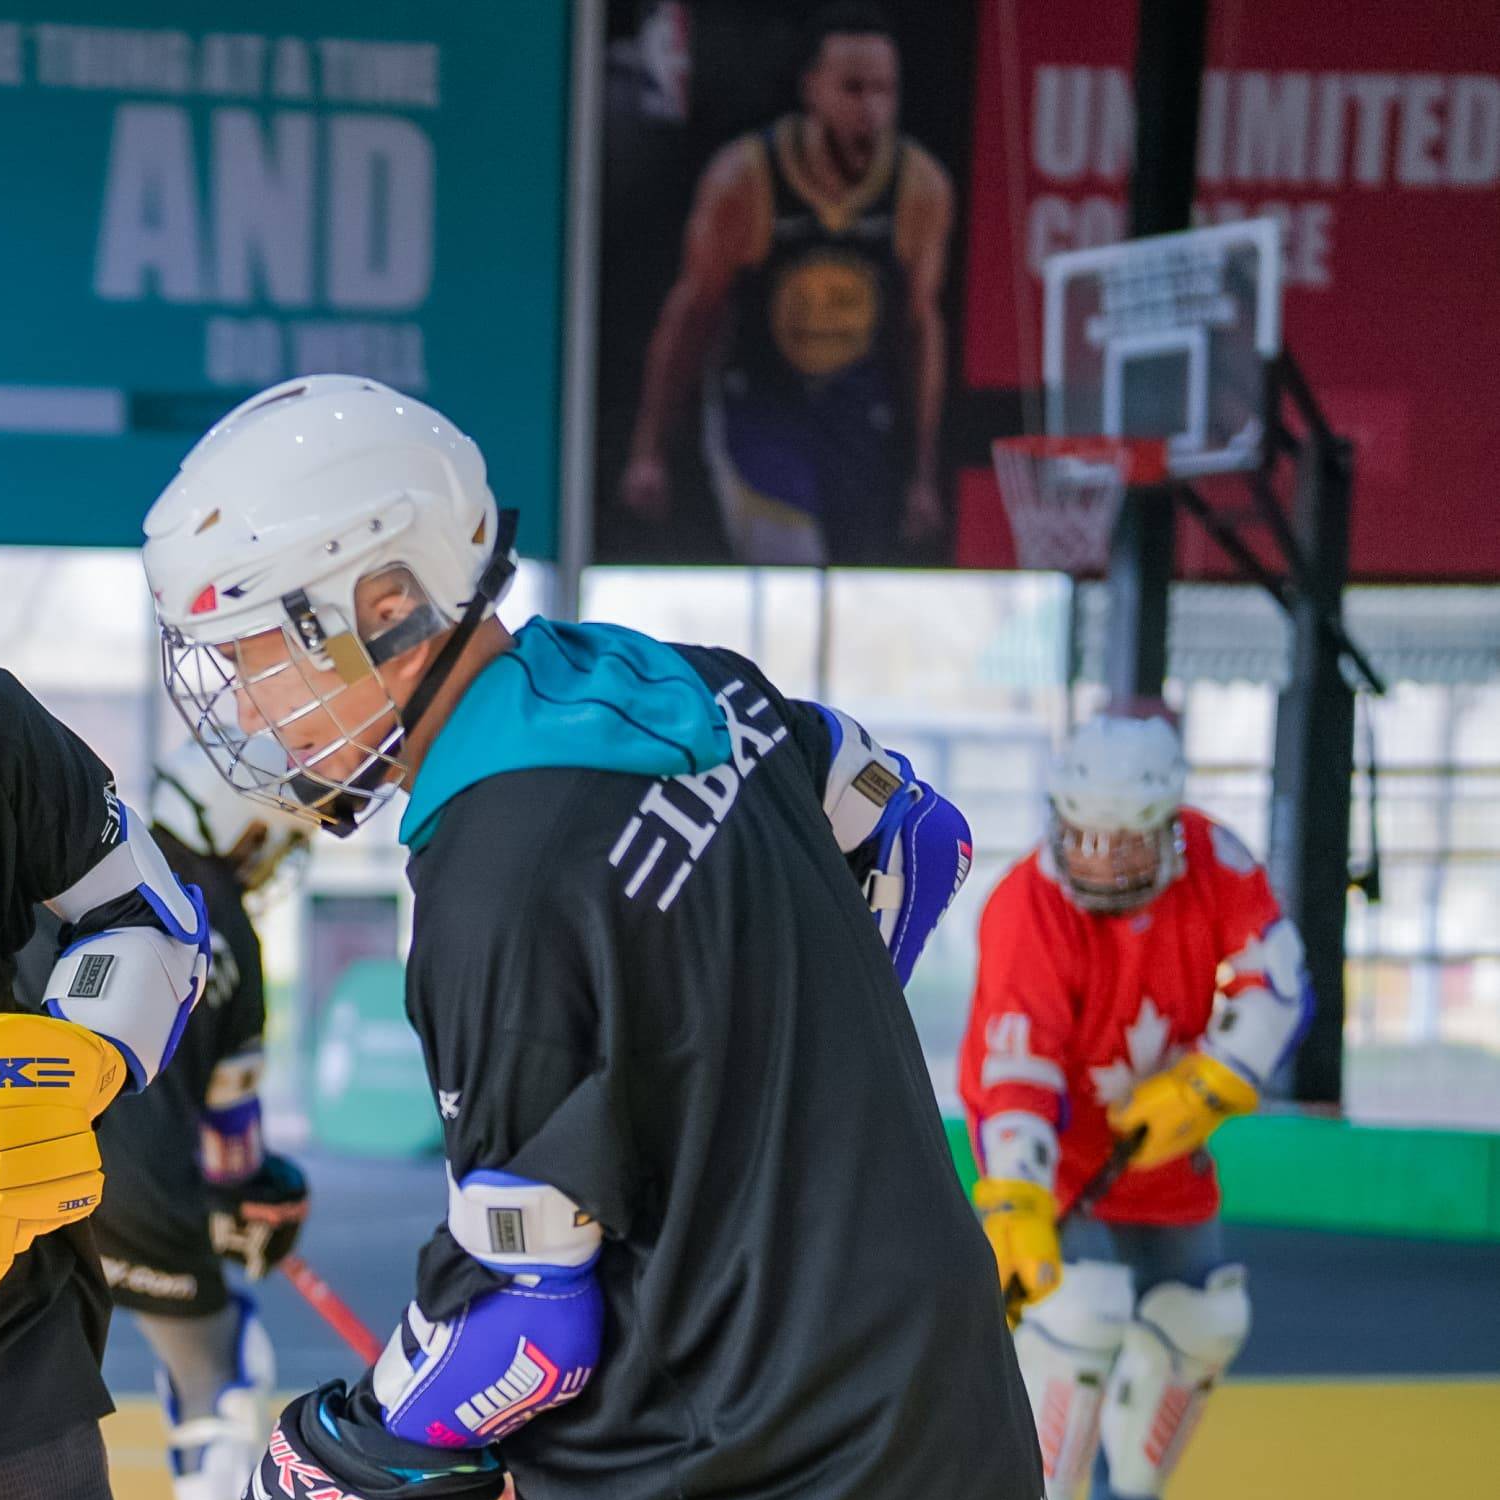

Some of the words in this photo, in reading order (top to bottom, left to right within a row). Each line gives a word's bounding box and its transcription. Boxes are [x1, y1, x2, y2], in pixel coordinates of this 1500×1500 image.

[36, 23, 190, 94] THING
[201, 35, 267, 96] AT
[273, 39, 312, 98] A
[319, 39, 440, 107] TIME
[1032, 63, 1500, 188] UNIMITED
[95, 102, 435, 310] AND
